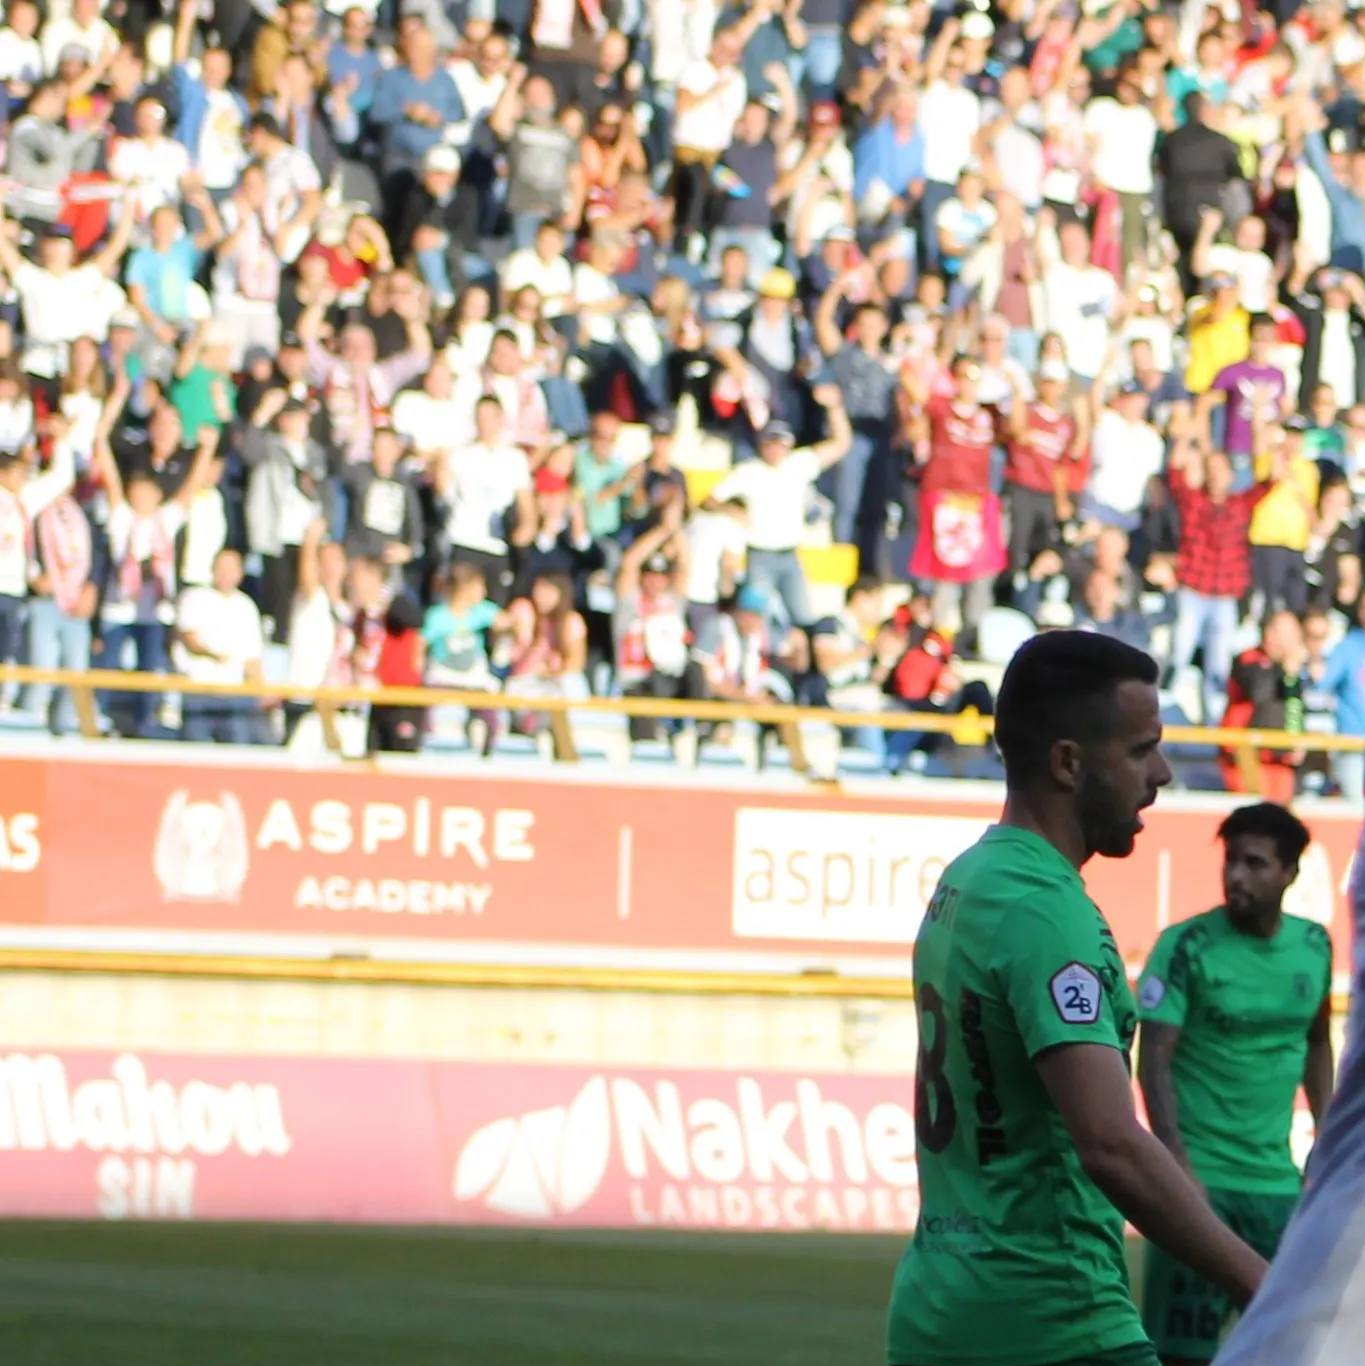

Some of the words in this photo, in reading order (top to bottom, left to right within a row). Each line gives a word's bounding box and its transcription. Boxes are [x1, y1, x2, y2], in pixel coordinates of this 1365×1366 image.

[256, 796, 536, 870] ASPIRE
[295, 875, 492, 917] ACADEMY
[744, 835, 949, 917] aspire
[0, 1052, 291, 1157] Mahou
[610, 1076, 918, 1186] Nakhe
[96, 1155, 197, 1220] SIN
